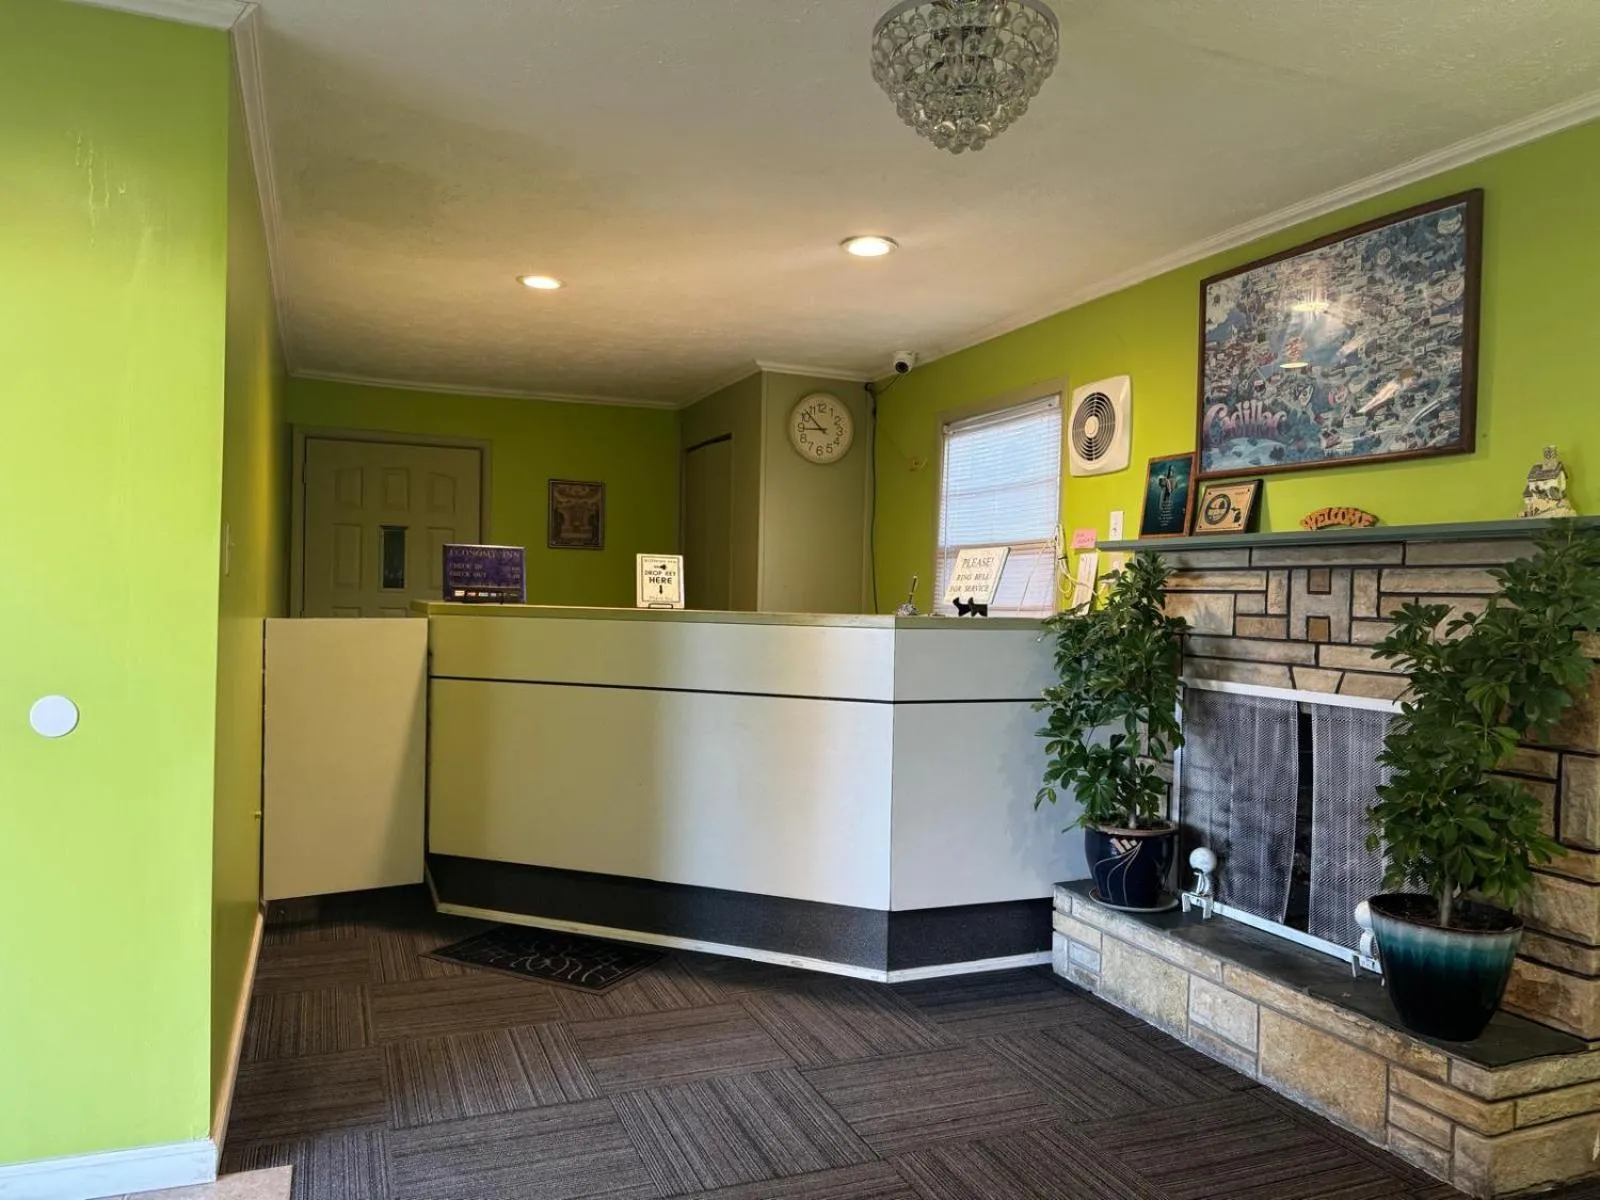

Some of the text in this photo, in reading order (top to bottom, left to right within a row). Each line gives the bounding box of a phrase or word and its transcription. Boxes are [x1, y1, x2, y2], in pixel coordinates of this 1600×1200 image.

[809, 405, 815, 417] 11
[817, 403, 827, 413] 12
[829, 407, 834, 417] 1
[835, 416, 841, 426] 2
[1203, 399, 1288, 446] Cadillac
[798, 423, 805, 433] 9
[836, 426, 843, 437] 3
[800, 433, 807, 443] 8
[833, 437, 840, 446] 4
[807, 441, 814, 451] 7
[826, 443, 833, 454] 5
[816, 446, 823, 457] 6
[1303, 507, 1378, 530] WELCOME
[962, 556, 994, 569] PLEASE!
[648, 576, 673, 584] HERE
[956, 573, 990, 581] RING BELL
[949, 584, 989, 592] FOR SERVICE
